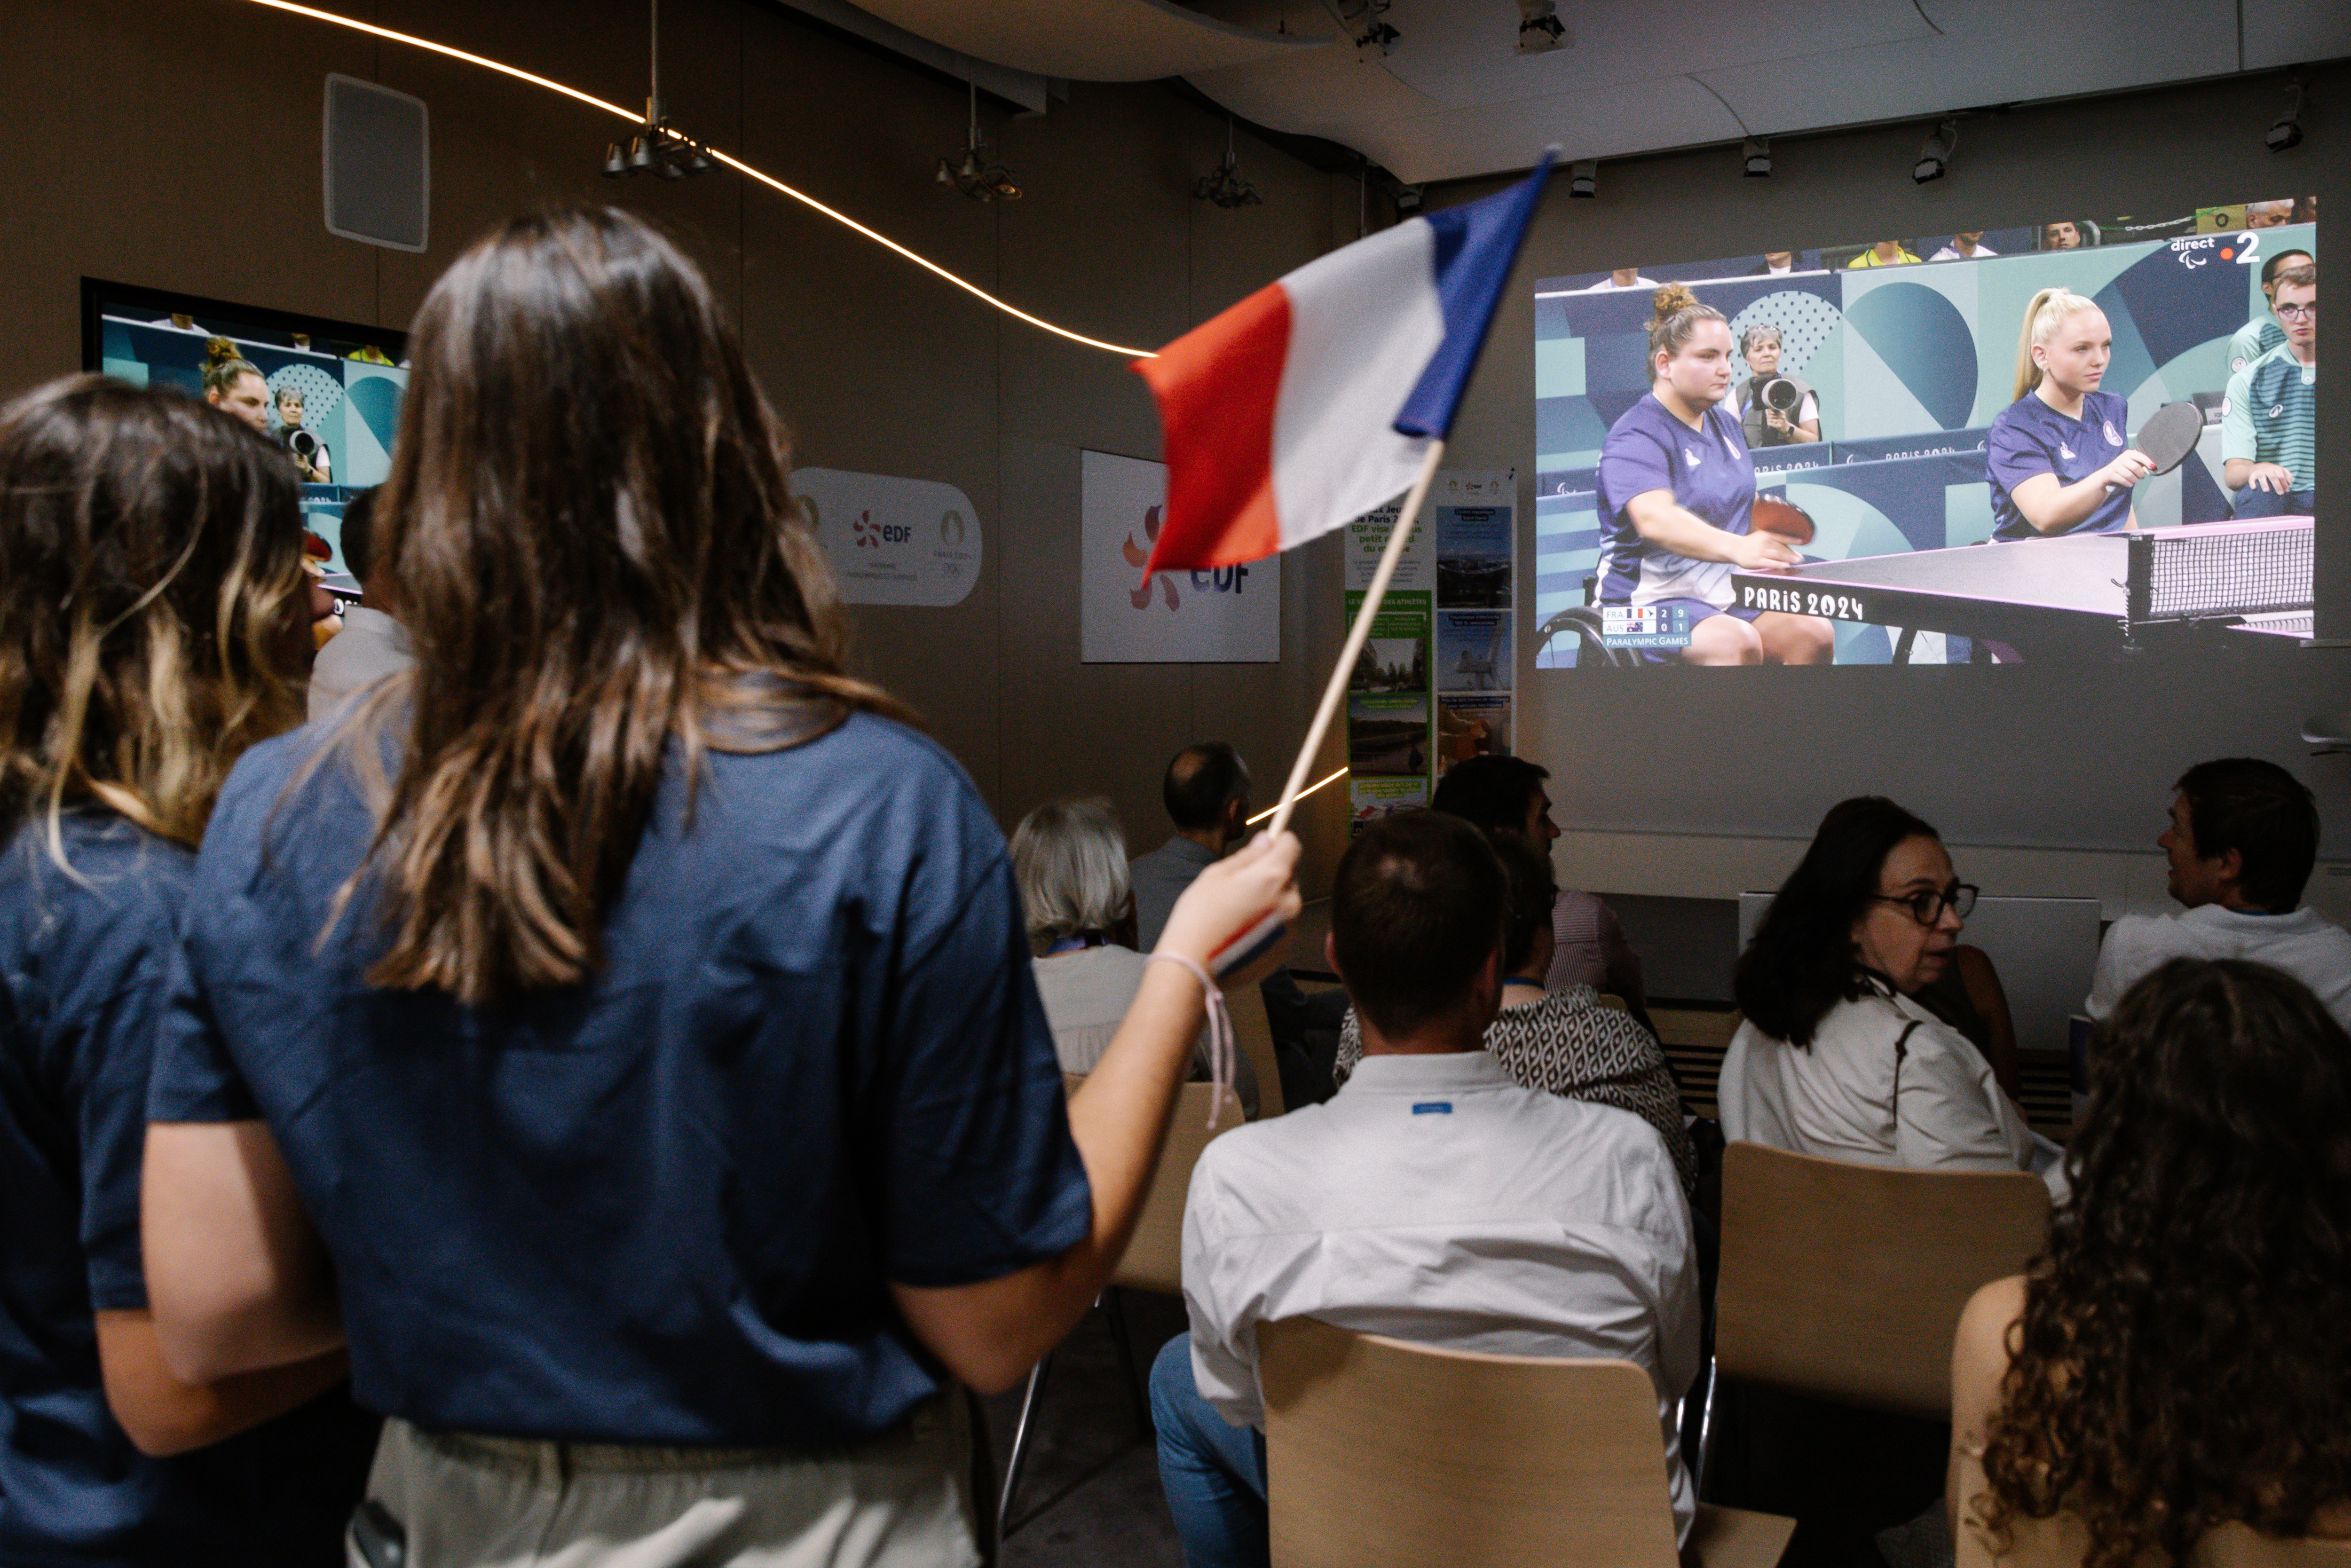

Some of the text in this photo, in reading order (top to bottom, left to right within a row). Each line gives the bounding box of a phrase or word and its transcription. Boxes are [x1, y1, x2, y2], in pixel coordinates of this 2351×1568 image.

[2170, 237, 2215, 251] direct
[2236, 231, 2260, 264] 2
[1661, 609, 1667, 618] 2
[1678, 609, 1684, 617] 9
[1807, 593, 1862, 620] 2024
[1679, 623, 1683, 631] 1
